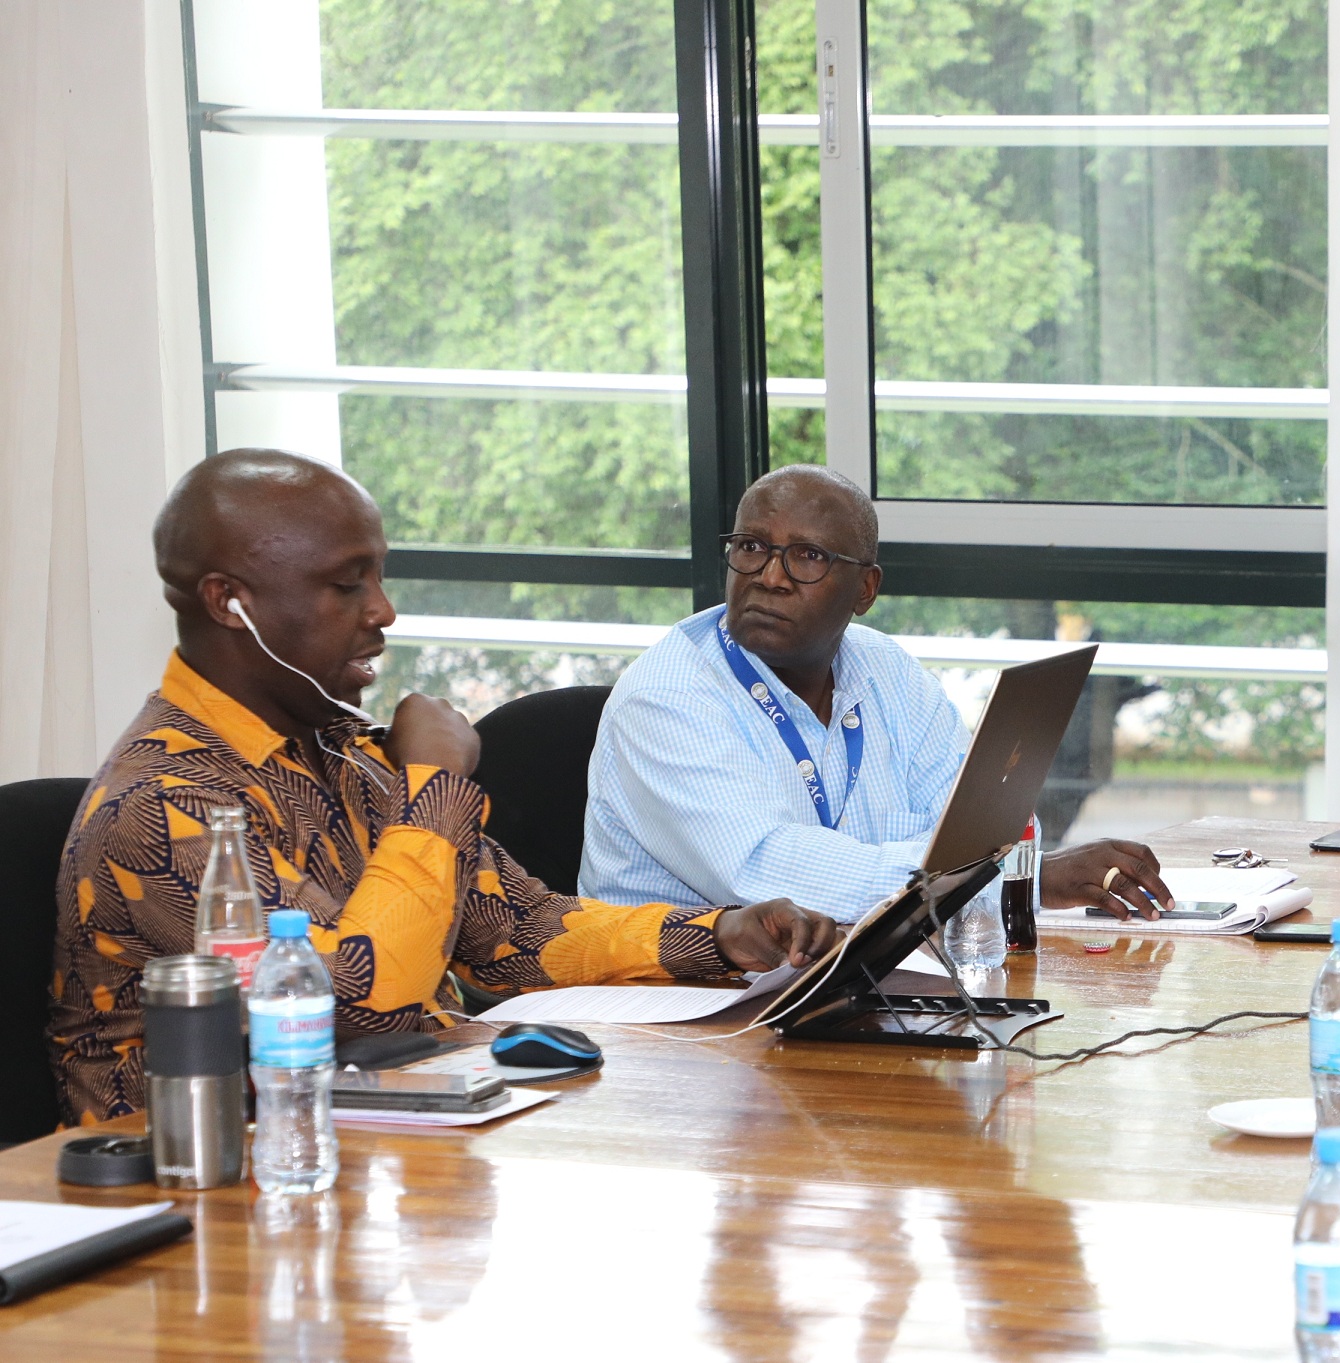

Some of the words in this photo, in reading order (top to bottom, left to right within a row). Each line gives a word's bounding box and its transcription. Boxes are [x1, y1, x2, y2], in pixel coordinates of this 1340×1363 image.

[720, 628, 736, 652] EAC
[760, 694, 786, 725] EAC
[803, 774, 825, 805] EAC
